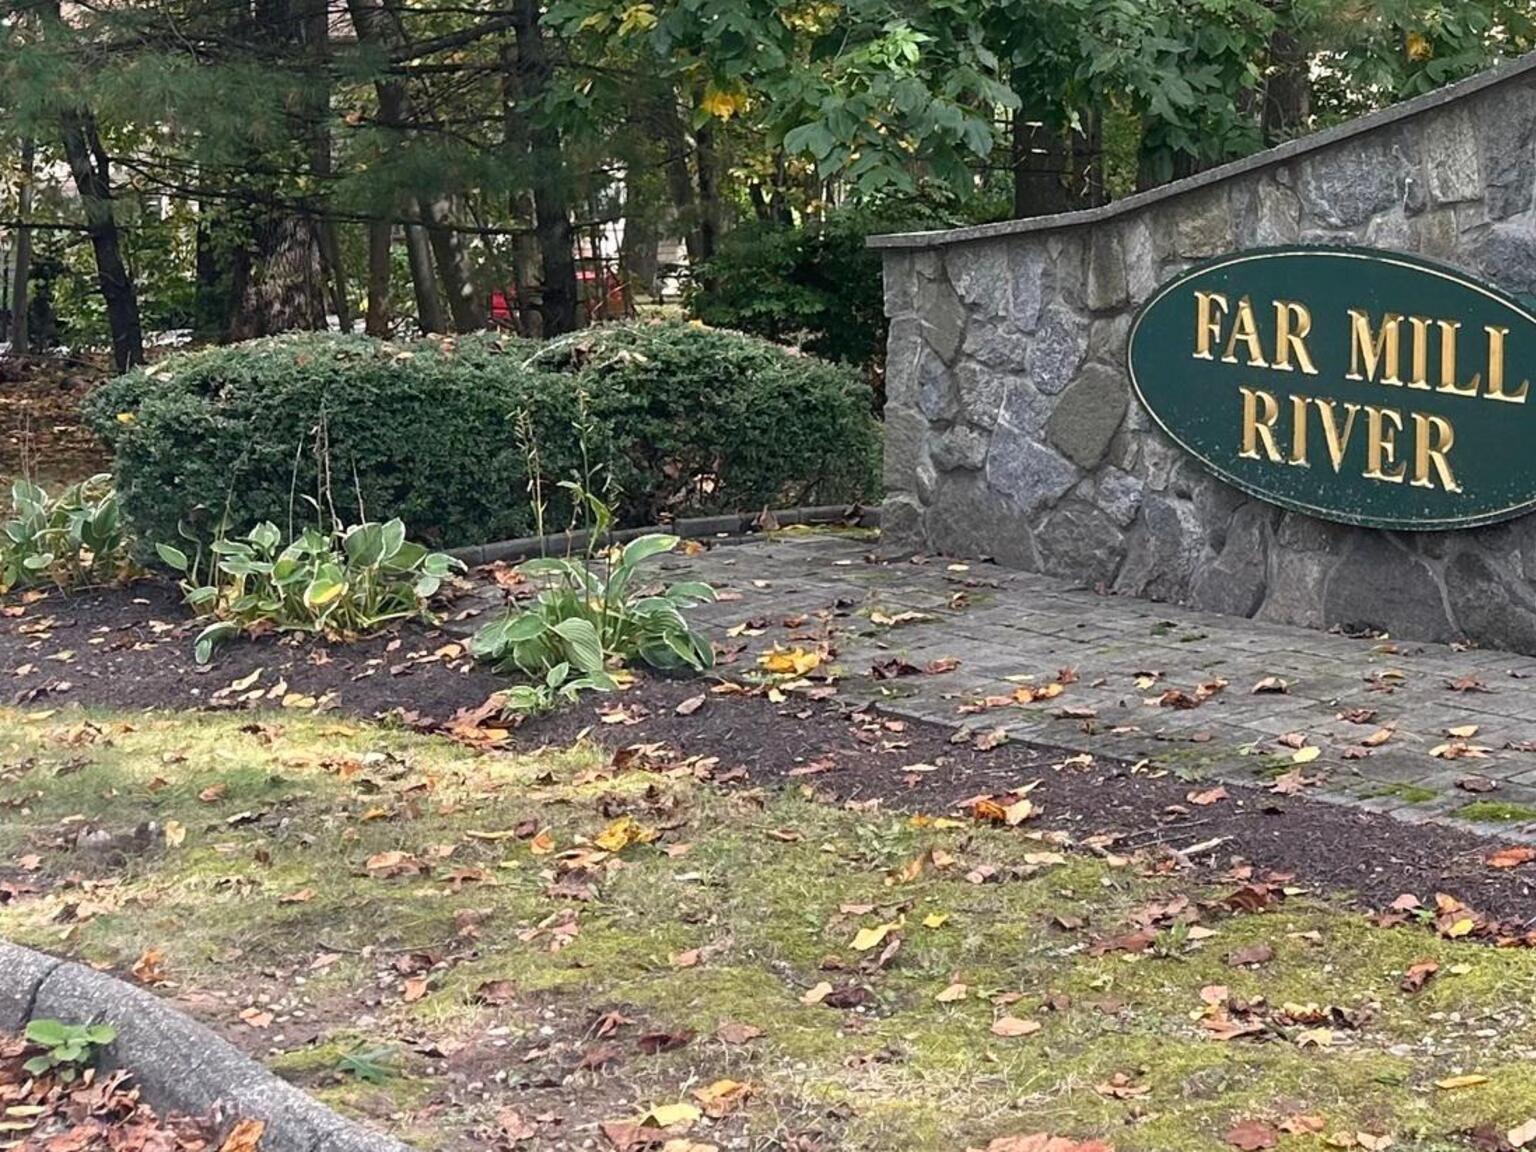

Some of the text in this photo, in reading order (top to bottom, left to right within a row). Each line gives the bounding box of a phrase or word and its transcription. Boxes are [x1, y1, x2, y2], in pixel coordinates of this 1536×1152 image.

[1193, 290, 1529, 405] FAR MILL
[1238, 385, 1463, 493] RIVER
